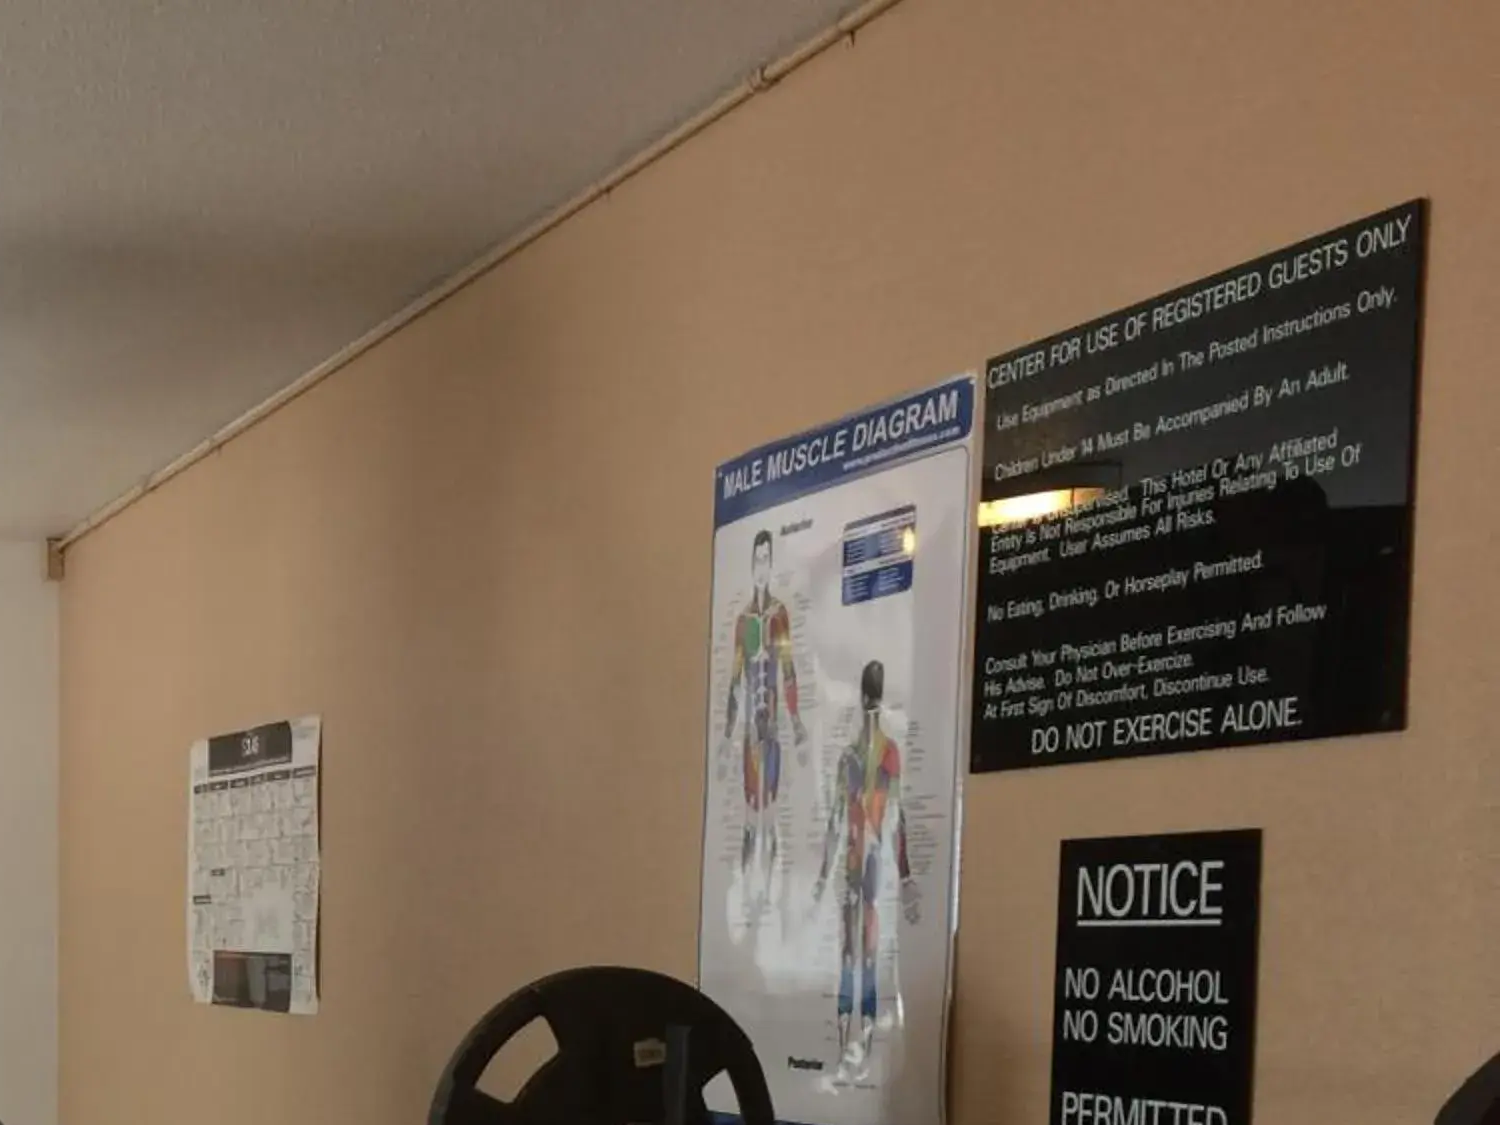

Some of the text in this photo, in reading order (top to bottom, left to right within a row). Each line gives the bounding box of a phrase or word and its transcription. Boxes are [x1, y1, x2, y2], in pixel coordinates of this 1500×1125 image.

[987, 213, 1412, 390] CENTER FOR USE OF REGISTERED GUESTS ONLY
[996, 412, 1018, 431] Use
[1021, 390, 1084, 423] Equipment
[1105, 361, 1157, 396] Directed
[1161, 357, 1175, 376] In
[1179, 350, 1204, 372] The
[1209, 327, 1258, 361] Posted
[1263, 301, 1351, 344] Instructions
[1356, 285, 1397, 312] Only.
[722, 459, 763, 500] MALE
[766, 429, 849, 482] MUSCLE
[851, 389, 959, 452] DIAGRAM
[994, 456, 1039, 481] Children
[1041, 444, 1076, 468] Under
[1097, 429, 1129, 451] Must
[1133, 421, 1151, 443] Be
[1155, 389, 1249, 434] Accompanied
[1254, 385, 1273, 407] By
[1278, 377, 1301, 398] An
[1140, 476, 1167, 496] This
[1171, 463, 1207, 490] Hotel
[1211, 457, 1229, 479] Or
[1234, 451, 1263, 473] Any
[1268, 426, 1338, 464] Affiliated
[990, 533, 1023, 554] Entity
[1025, 528, 1037, 545] Is
[1039, 522, 1061, 542] Not
[1064, 503, 1138, 537] Responsible
[1141, 496, 1163, 517] For
[1167, 485, 1215, 510] Injuries
[1219, 470, 1277, 497] Relating
[1282, 459, 1300, 481] To
[1304, 454, 1336, 476] Use
[1340, 442, 1364, 468] Of
[1059, 538, 1089, 557] User
[1091, 524, 1151, 551] Assumes
[1155, 514, 1173, 535] All
[1176, 507, 1217, 532] Risks.
[987, 604, 1005, 623] No
[1104, 579, 1121, 599] Or
[1124, 568, 1190, 595] Horseplay
[1193, 547, 1265, 582] Permitted.
[985, 602, 1328, 675] Consult Your Physician Before Exercising And Follow
[983, 680, 1003, 697] His
[1054, 668, 1072, 688] Do
[1075, 665, 1098, 684] Not
[983, 703, 998, 720] At
[1000, 699, 1026, 718] First
[1027, 695, 1055, 717] Sign
[1057, 691, 1073, 711] Of
[1153, 671, 1233, 697] Discontinue
[1237, 665, 1272, 686] Use.
[1031, 696, 1303, 755] DO NOT EXERCISE ALONE.
[1075, 859, 1225, 918] NOTICE
[1064, 966, 1229, 1006] NO ALCOHOL
[1062, 1009, 1229, 1051] NO SMOKING
